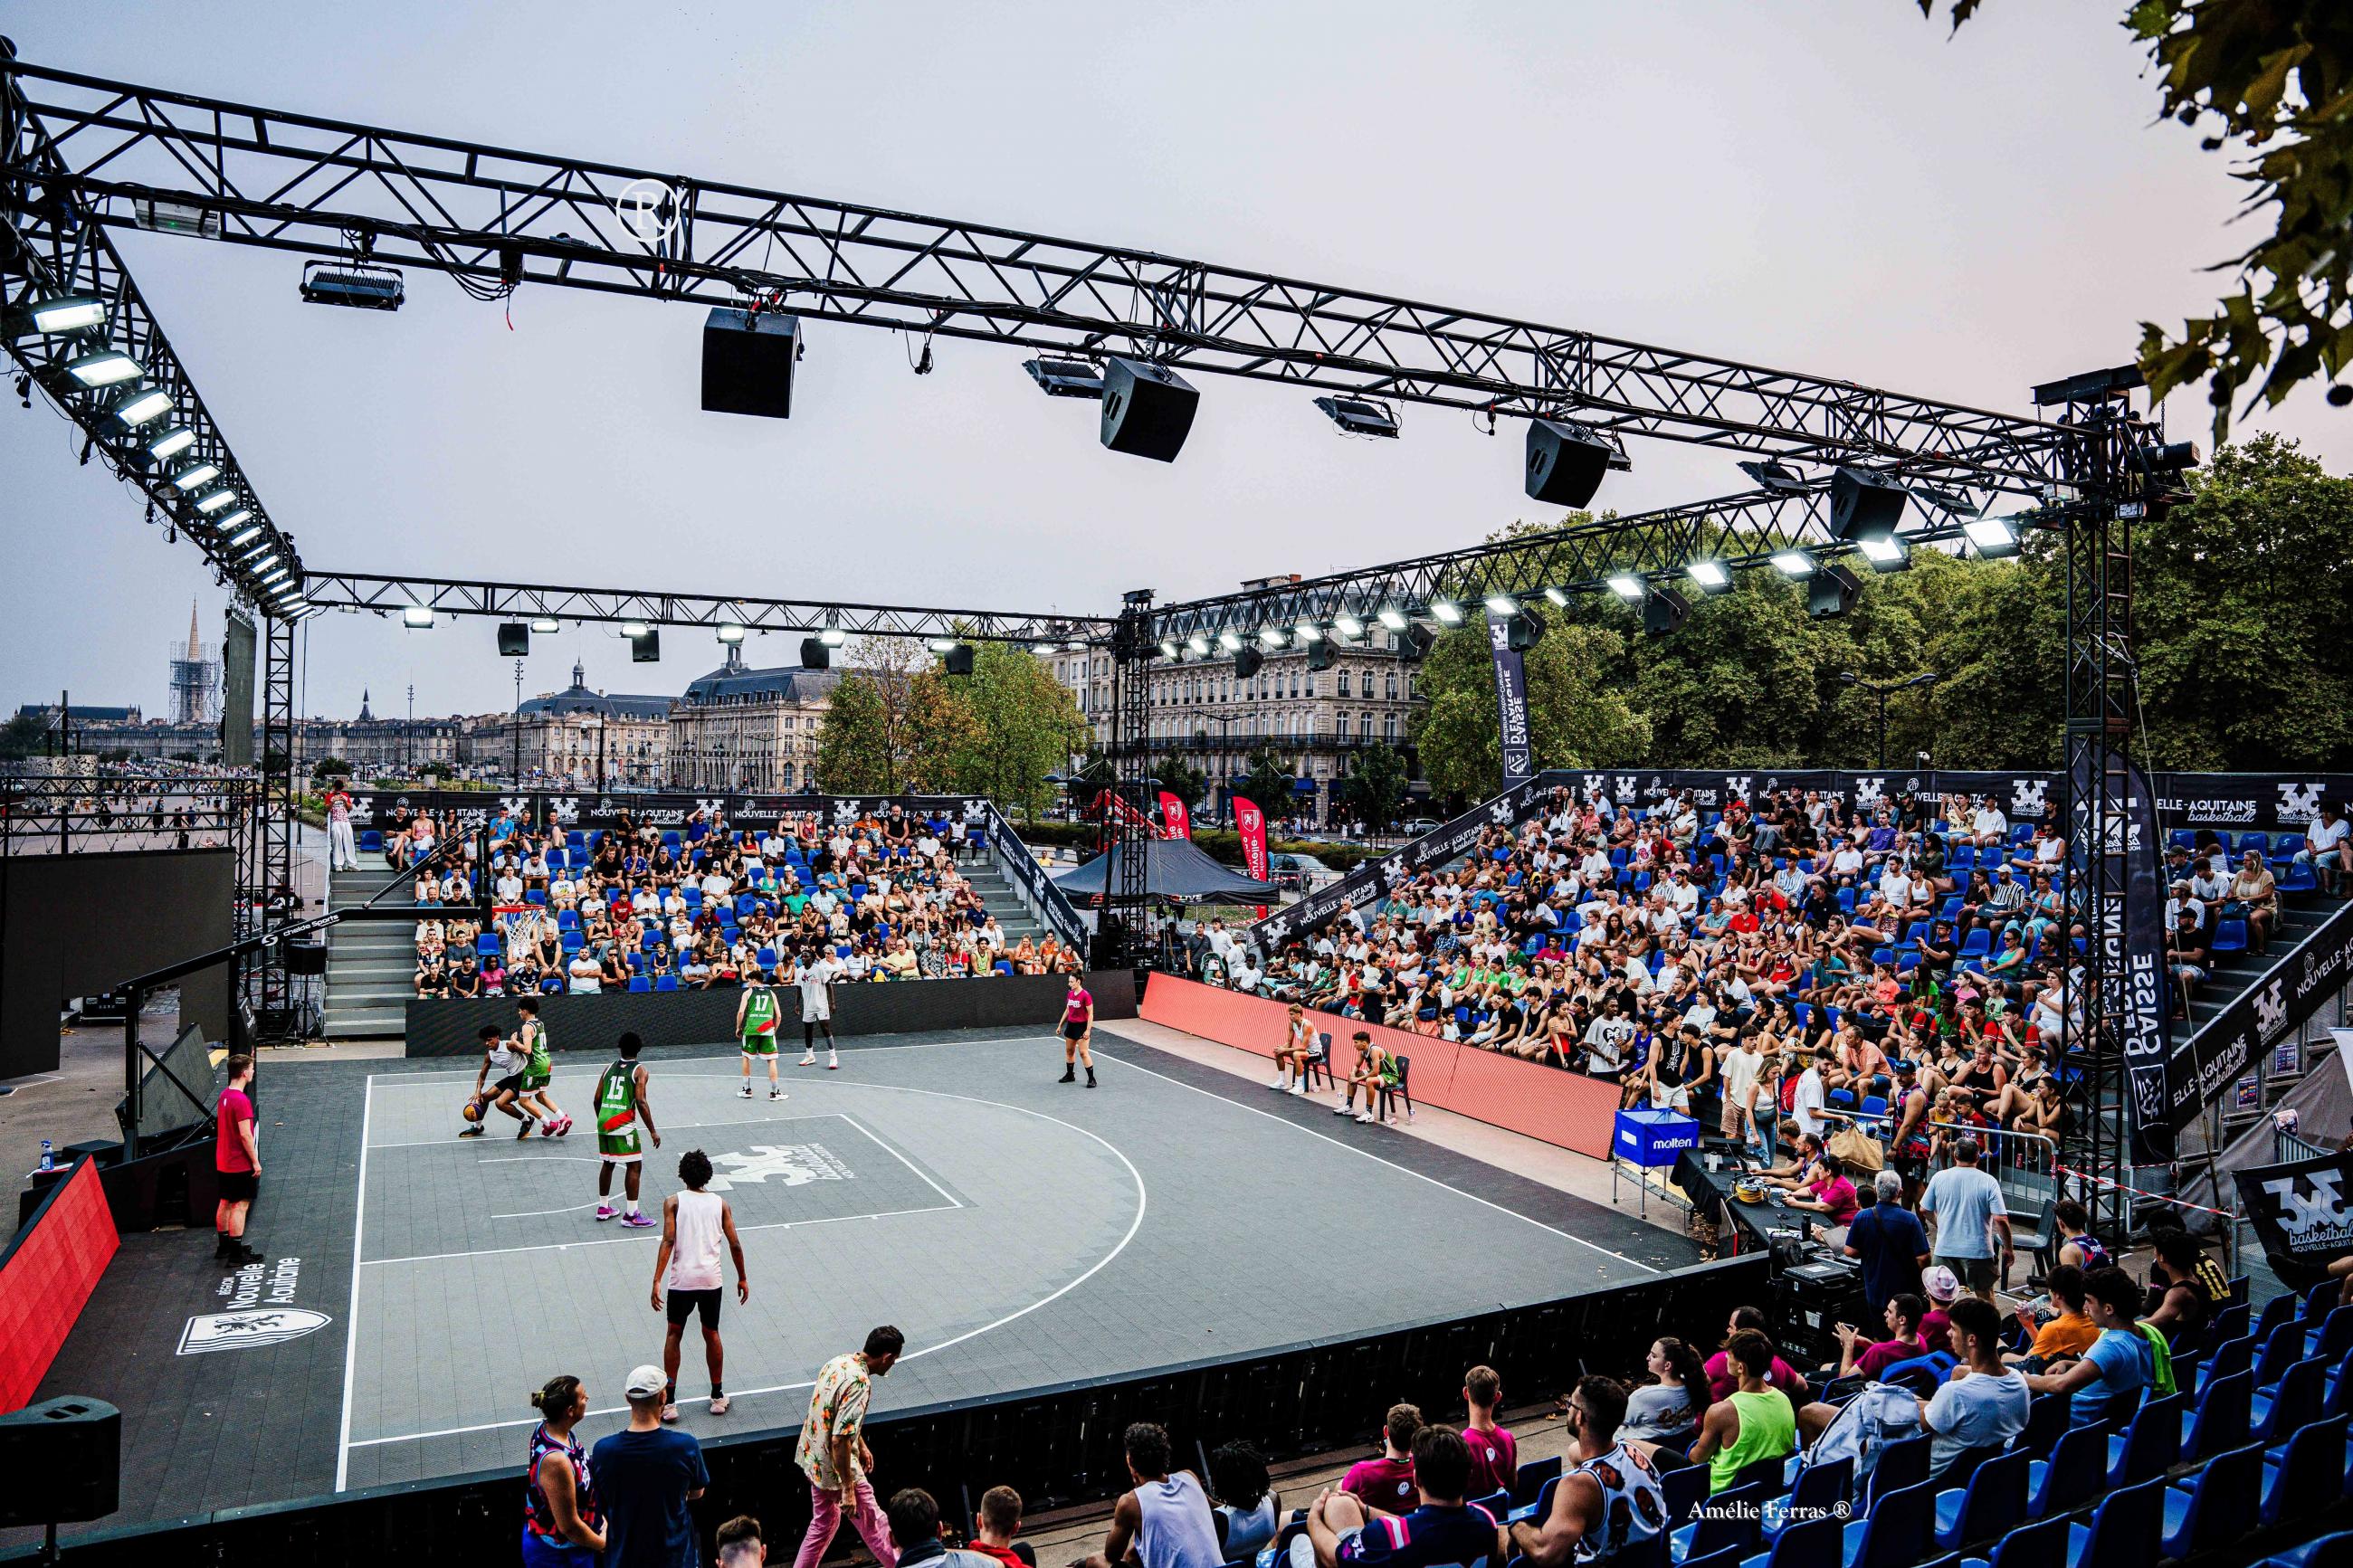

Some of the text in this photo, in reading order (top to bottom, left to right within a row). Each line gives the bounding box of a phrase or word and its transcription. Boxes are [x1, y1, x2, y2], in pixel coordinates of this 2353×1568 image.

[2187, 811, 2254, 822] basketball
[755, 994, 769, 1012] 17
[2200, 1043, 2247, 1099] basketball
[606, 1075, 625, 1100] 15
[1653, 1136, 1692, 1150] molten
[2290, 1221, 2353, 1246] basketbal
[227, 1263, 265, 1309] Nouvelle
[263, 1257, 300, 1304] Aquitaine
